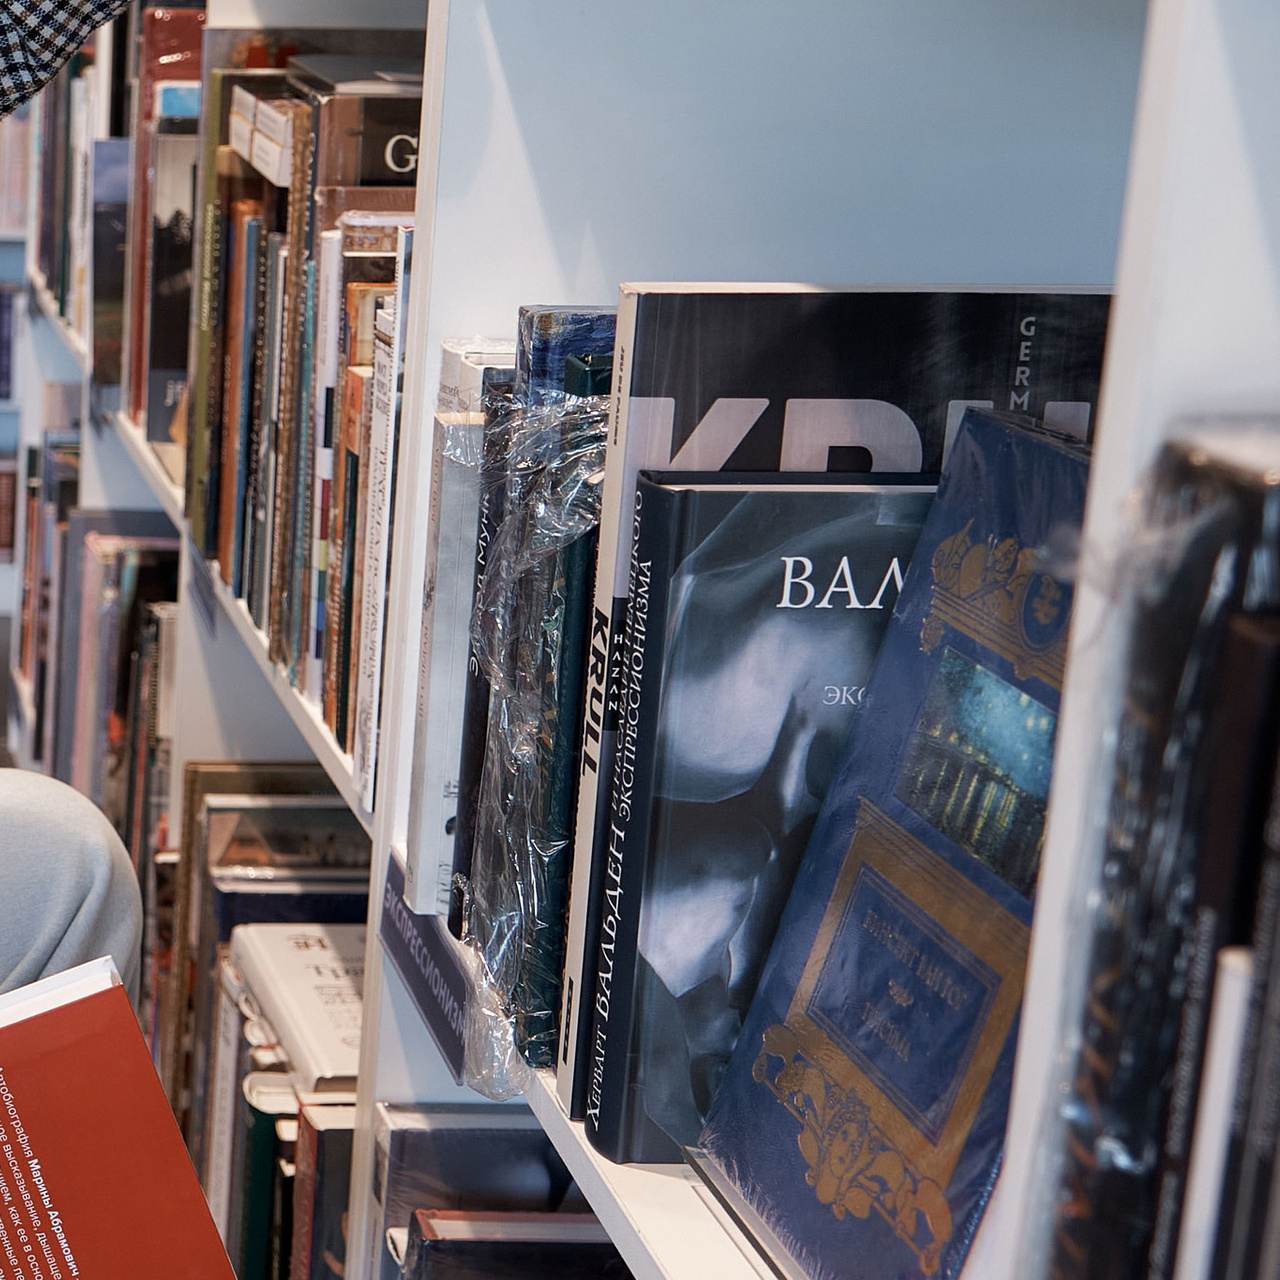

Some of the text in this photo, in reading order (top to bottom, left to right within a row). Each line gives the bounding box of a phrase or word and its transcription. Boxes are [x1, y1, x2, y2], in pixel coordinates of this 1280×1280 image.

[581, 609, 610, 777] KRULL
[618, 558, 652, 820] ЭКСПРЕССИОНИЗМА
[381, 882, 467, 1042] ЭКСПРЕССИОНИЗМ
[596, 827, 624, 1021] ВАЛЬДЕН
[2, 1144, 41, 1231] высказывание,
[8, 1206, 23, 1227] как
[17, 1228, 29, 1243] ее
[23, 1244, 32, 1253] в
[27, 1158, 53, 1209] Марины
[47, 1211, 80, 1277] Абрамович
